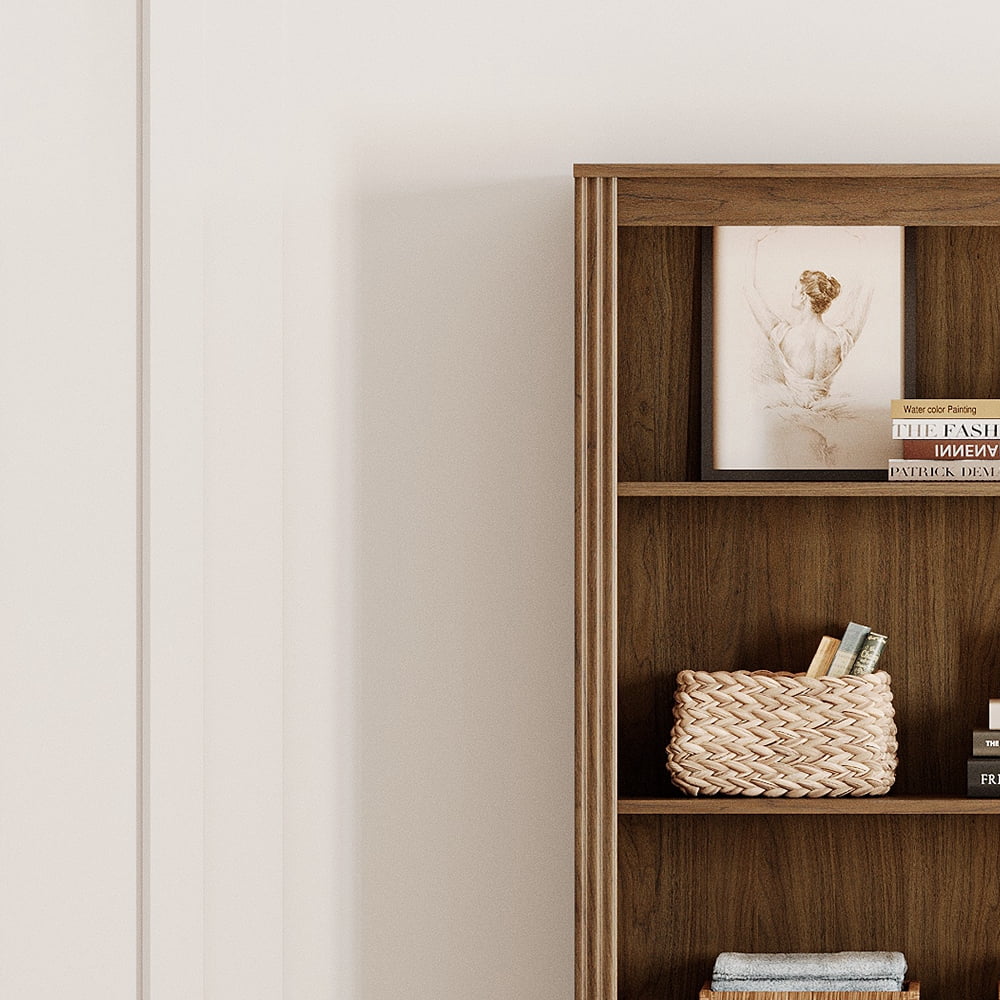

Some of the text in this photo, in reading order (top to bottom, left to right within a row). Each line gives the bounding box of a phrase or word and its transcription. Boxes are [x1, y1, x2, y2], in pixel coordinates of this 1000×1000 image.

[903, 405, 977, 415] Water color Painting
[892, 424, 938, 437] THE
[890, 467, 955, 477] PATRICK
